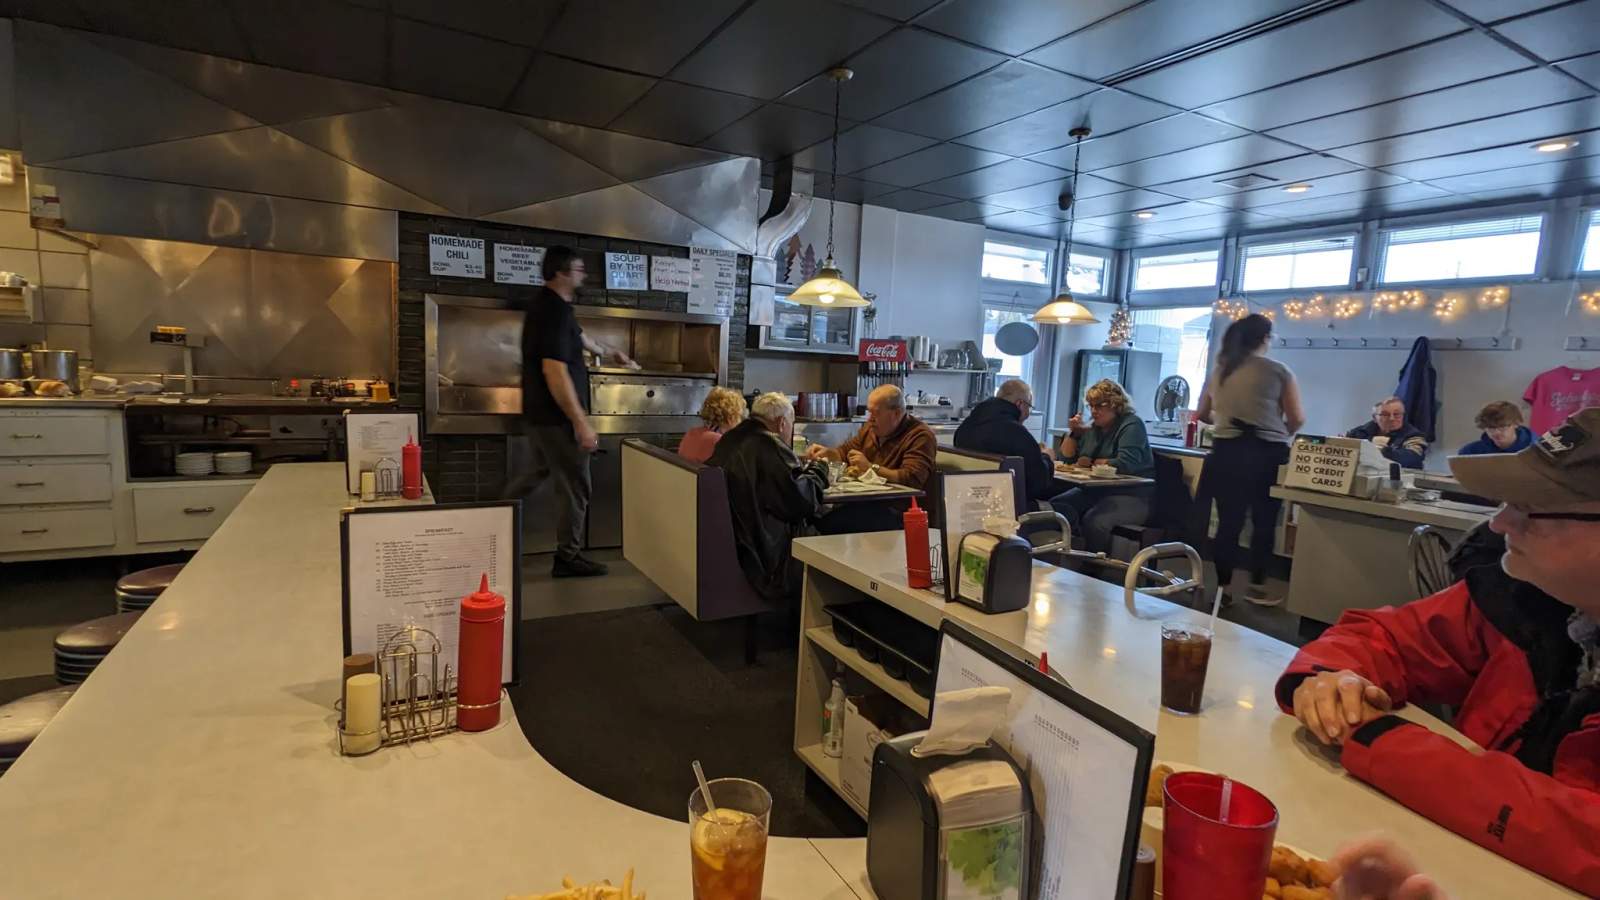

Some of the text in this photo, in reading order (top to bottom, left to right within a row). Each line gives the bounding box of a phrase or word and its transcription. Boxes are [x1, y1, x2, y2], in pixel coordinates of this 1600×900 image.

[431, 236, 484, 250] HOMEMADE
[446, 249, 469, 260] CHILI
[692, 247, 708, 255] DAILY
[612, 254, 641, 263] SOUP
[609, 262, 623, 270] BY
[625, 263, 645, 272] THE
[611, 271, 643, 280] QUART
[1297, 444, 1353, 457] CASH ONLY
[1295, 454, 1350, 467] NO CHECKS
[1295, 464, 1345, 477] NO CREDIT
[1311, 477, 1343, 488] CARDS
